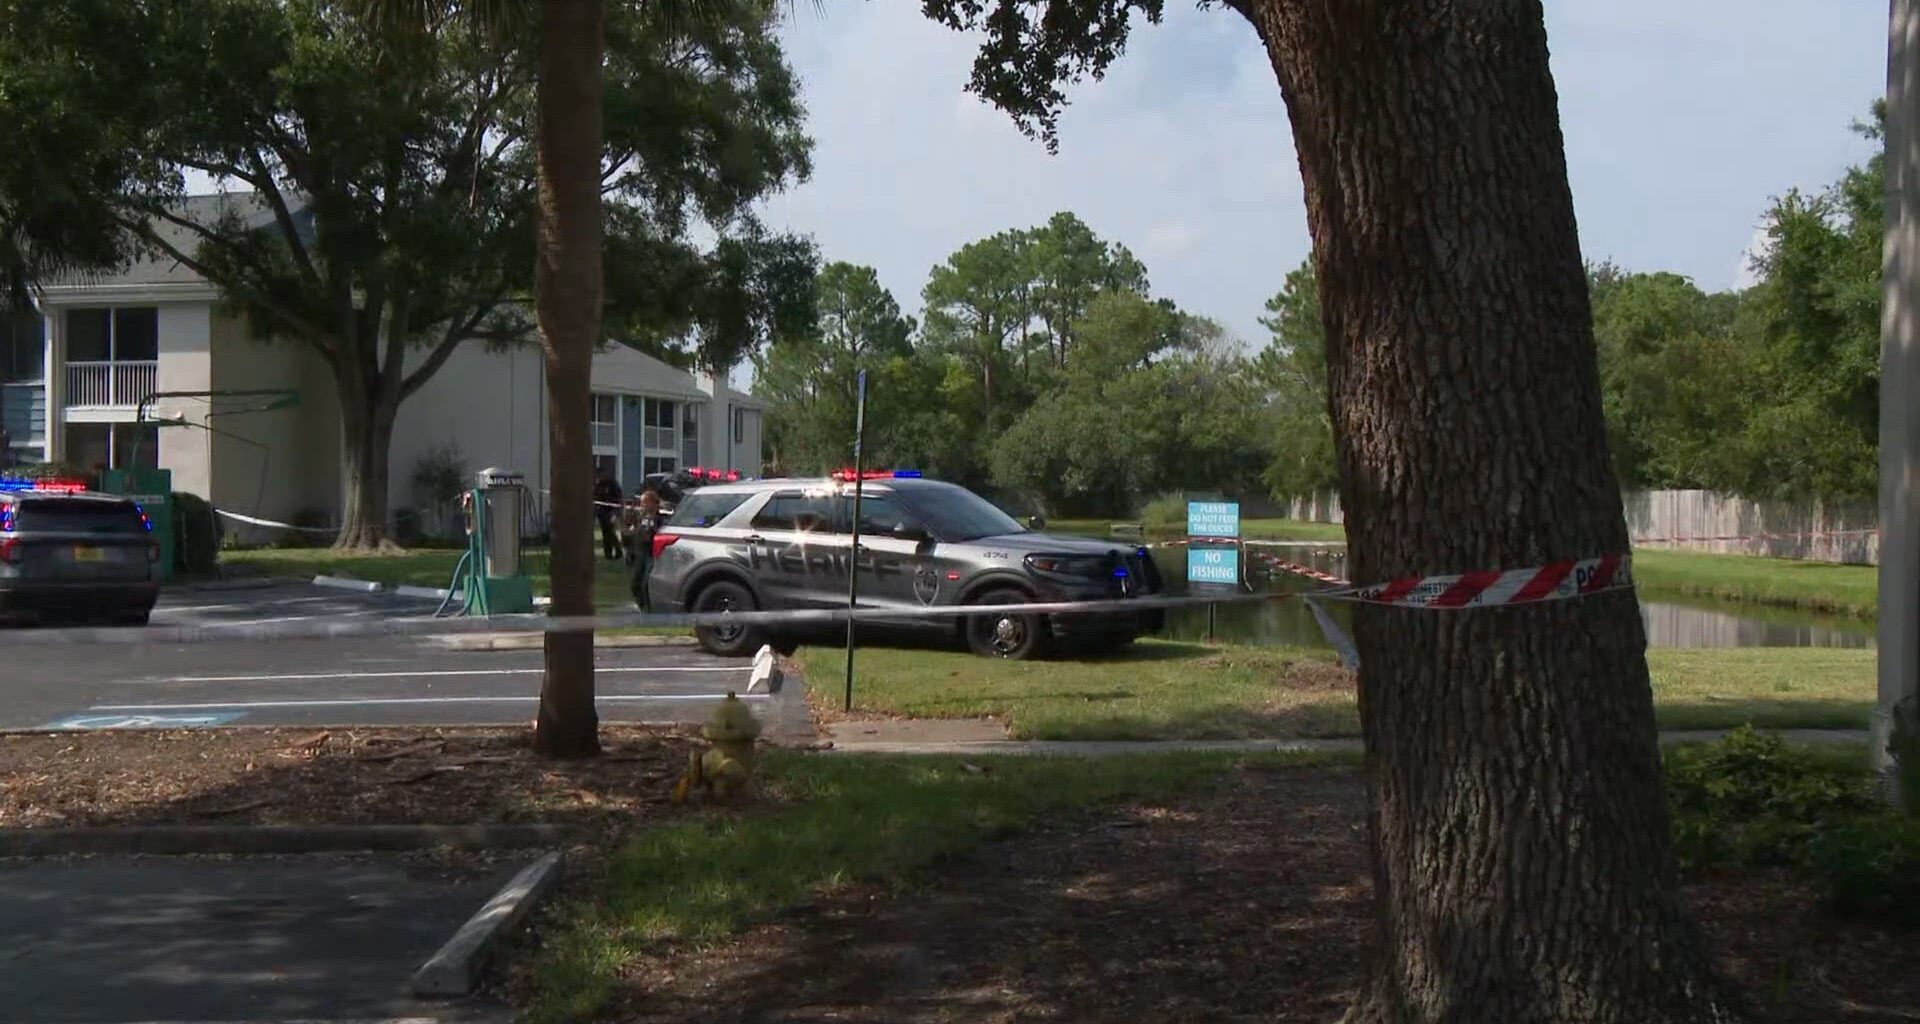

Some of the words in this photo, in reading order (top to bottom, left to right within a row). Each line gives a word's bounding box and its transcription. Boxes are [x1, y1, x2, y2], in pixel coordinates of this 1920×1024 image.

[1200, 504, 1226, 513] PLEASE
[1190, 512, 1201, 523] DO
[1202, 513, 1217, 523] NOT
[1218, 513, 1237, 524] FEED
[1192, 523, 1206, 532] THE
[1208, 524, 1234, 533] DUCKS
[1204, 551, 1221, 564] NO
[1191, 564, 1235, 579] FISHING
